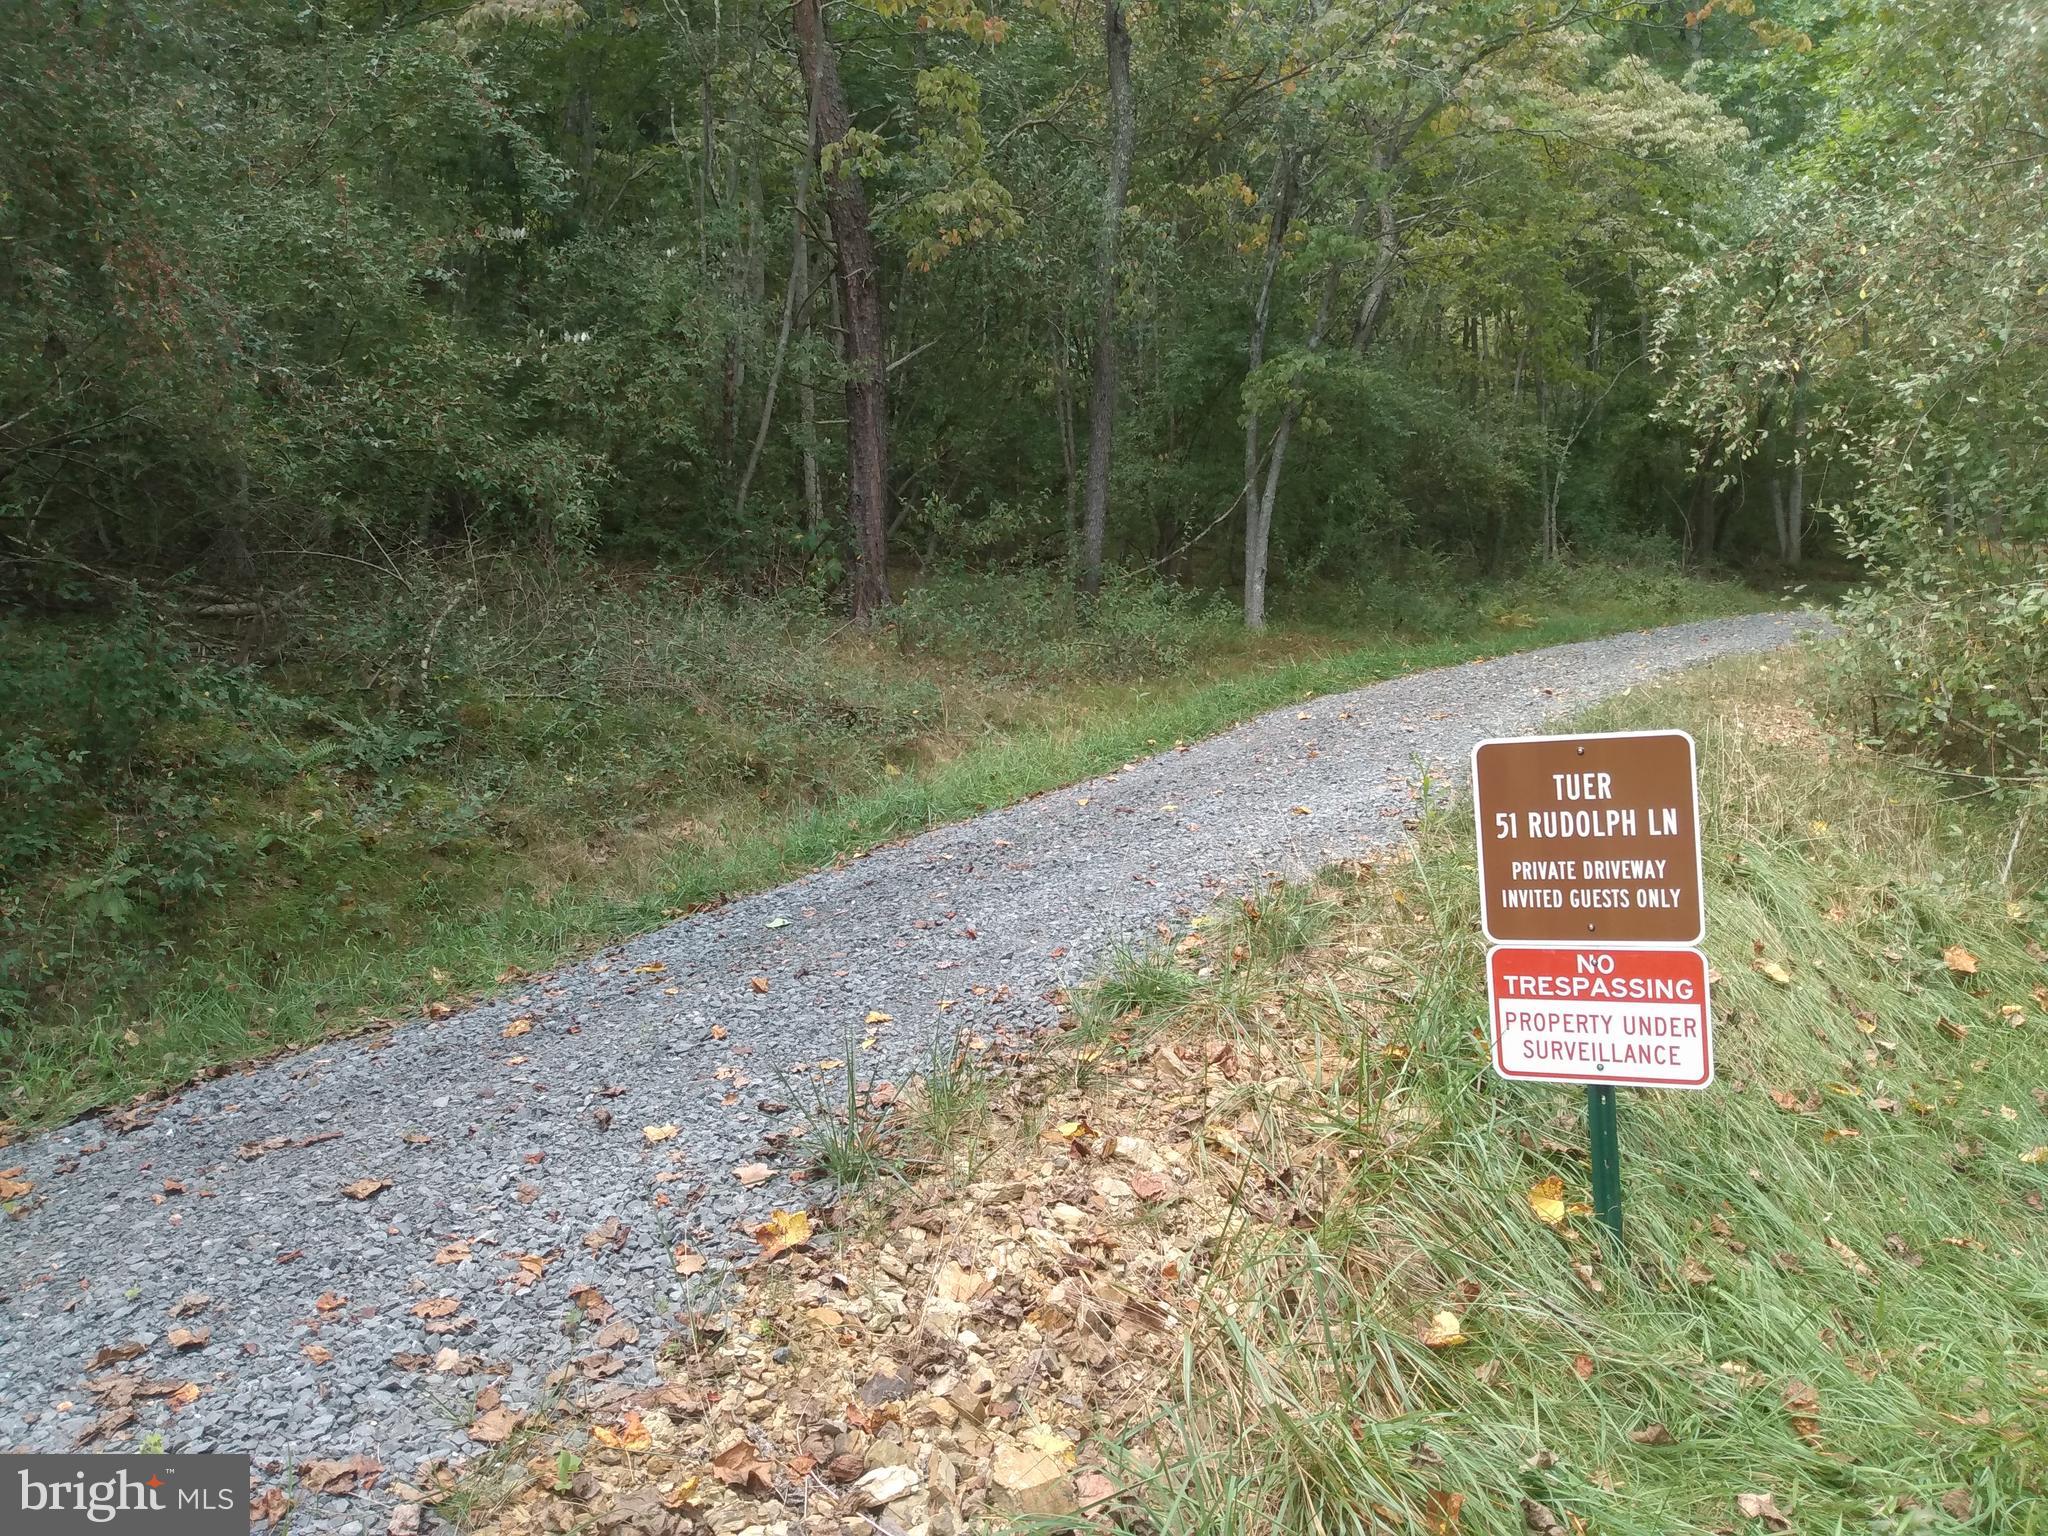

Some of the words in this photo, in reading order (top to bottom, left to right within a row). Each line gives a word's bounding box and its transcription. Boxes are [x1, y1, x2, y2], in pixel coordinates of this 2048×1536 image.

[1553, 772, 1612, 801] TUER
[1495, 812, 1518, 839] 51
[1528, 809, 1637, 838] RUDOLPH
[1648, 808, 1678, 836] LN
[1511, 861, 1576, 880] PRIVATE
[1582, 859, 1667, 880] DRIVEWAY
[1502, 888, 1563, 908] INVITED
[1569, 888, 1630, 908] GUESTS
[1636, 888, 1681, 908] ONLY
[1576, 953, 1615, 974] NO
[1503, 975, 1694, 1000] TRESPASSING
[1505, 1011, 1613, 1034] PROPERTY
[1623, 1015, 1697, 1038] UNDER
[1522, 1039, 1681, 1066] SURVEILLANCE
